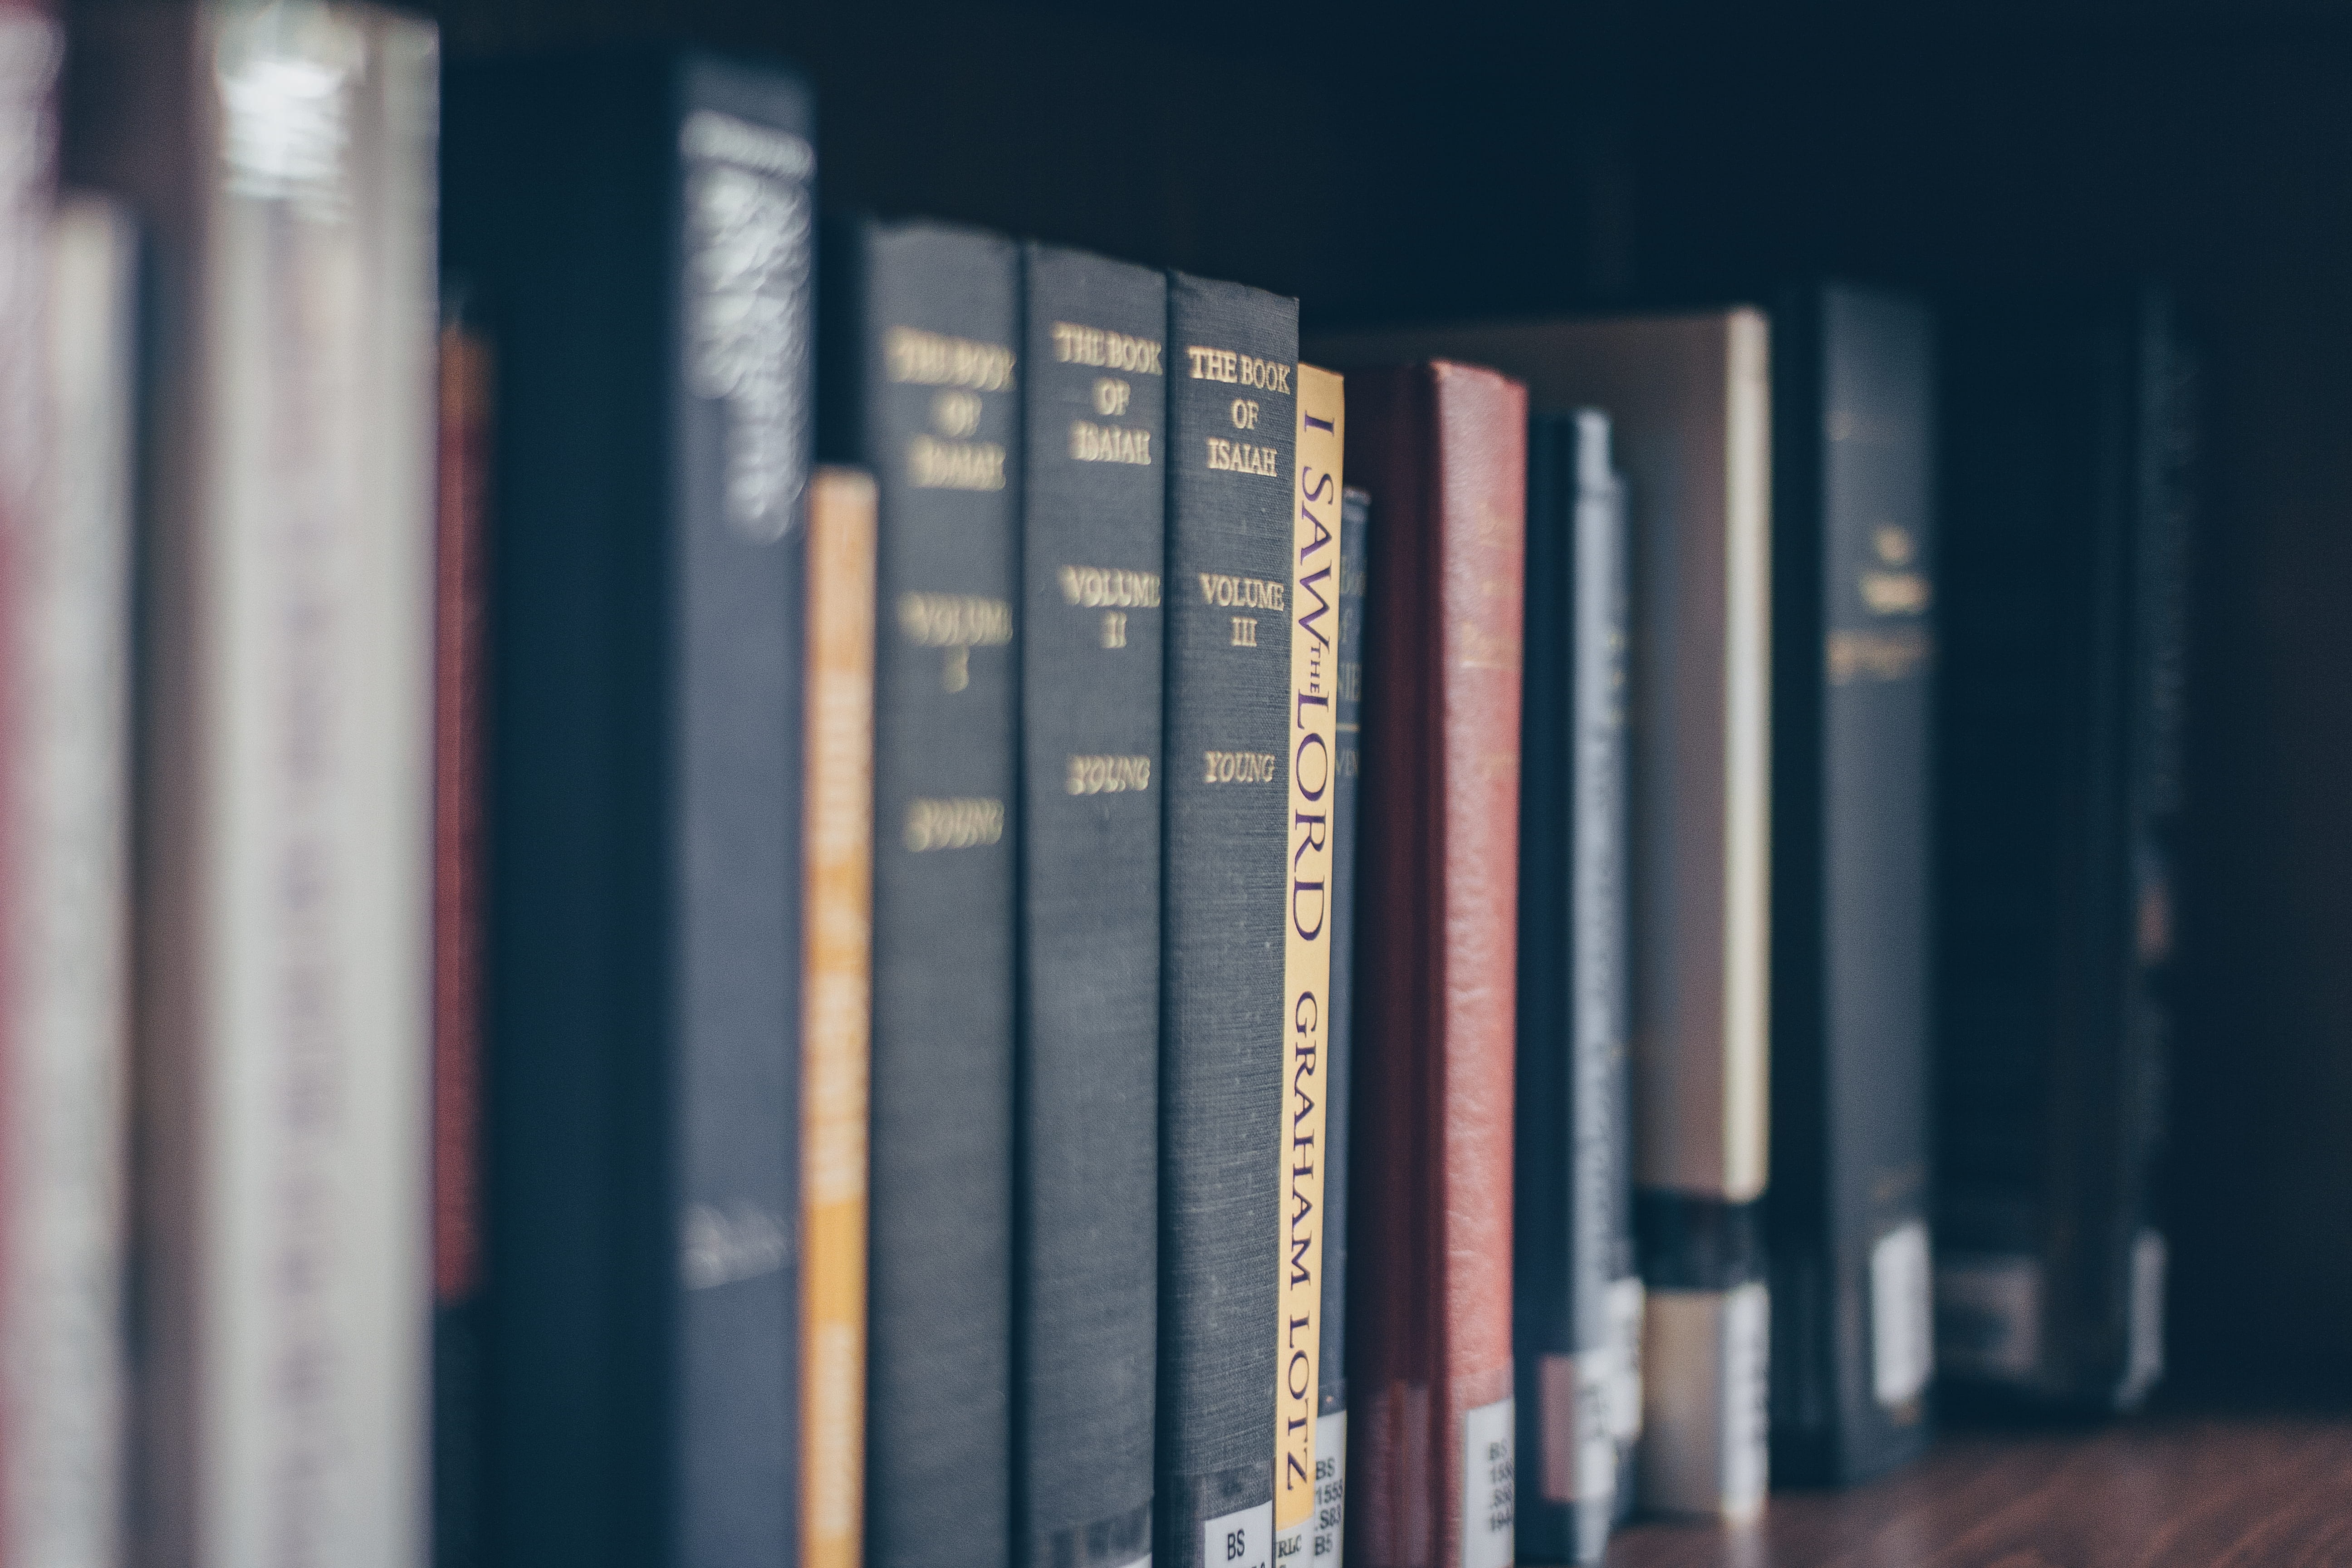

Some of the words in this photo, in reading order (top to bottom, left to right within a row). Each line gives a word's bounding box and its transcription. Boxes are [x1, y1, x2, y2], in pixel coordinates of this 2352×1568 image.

[1049, 320, 1104, 366] THE
[1106, 330, 1162, 376] BOOK
[1185, 345, 1238, 383] THE
[1240, 353, 1290, 395] BOOK
[1093, 377, 1131, 416] OF
[1230, 398, 1259, 430] OF
[1069, 420, 1152, 466] ISAIAH
[1303, 410, 1335, 437] I
[1206, 436, 1278, 477] ISAIAH
[1298, 466, 1334, 654] SAW
[1057, 564, 1161, 607] VOLUME
[1199, 573, 1285, 612] VOLUME
[1101, 611, 1127, 649] II
[1231, 616, 1258, 647] III
[1310, 642, 1321, 694] THE
[1066, 755, 1151, 795] YOUNG
[1204, 751, 1276, 784] YOUNG
[1293, 689, 1329, 941] LORD
[1290, 990, 1318, 1292] GRAHAM
[1288, 1311, 1310, 1491] LOTZ
[1315, 1456, 1336, 1481] BS
[1228, 1529, 1245, 1561] BS
[1276, 1534, 1302, 1558] RLC
